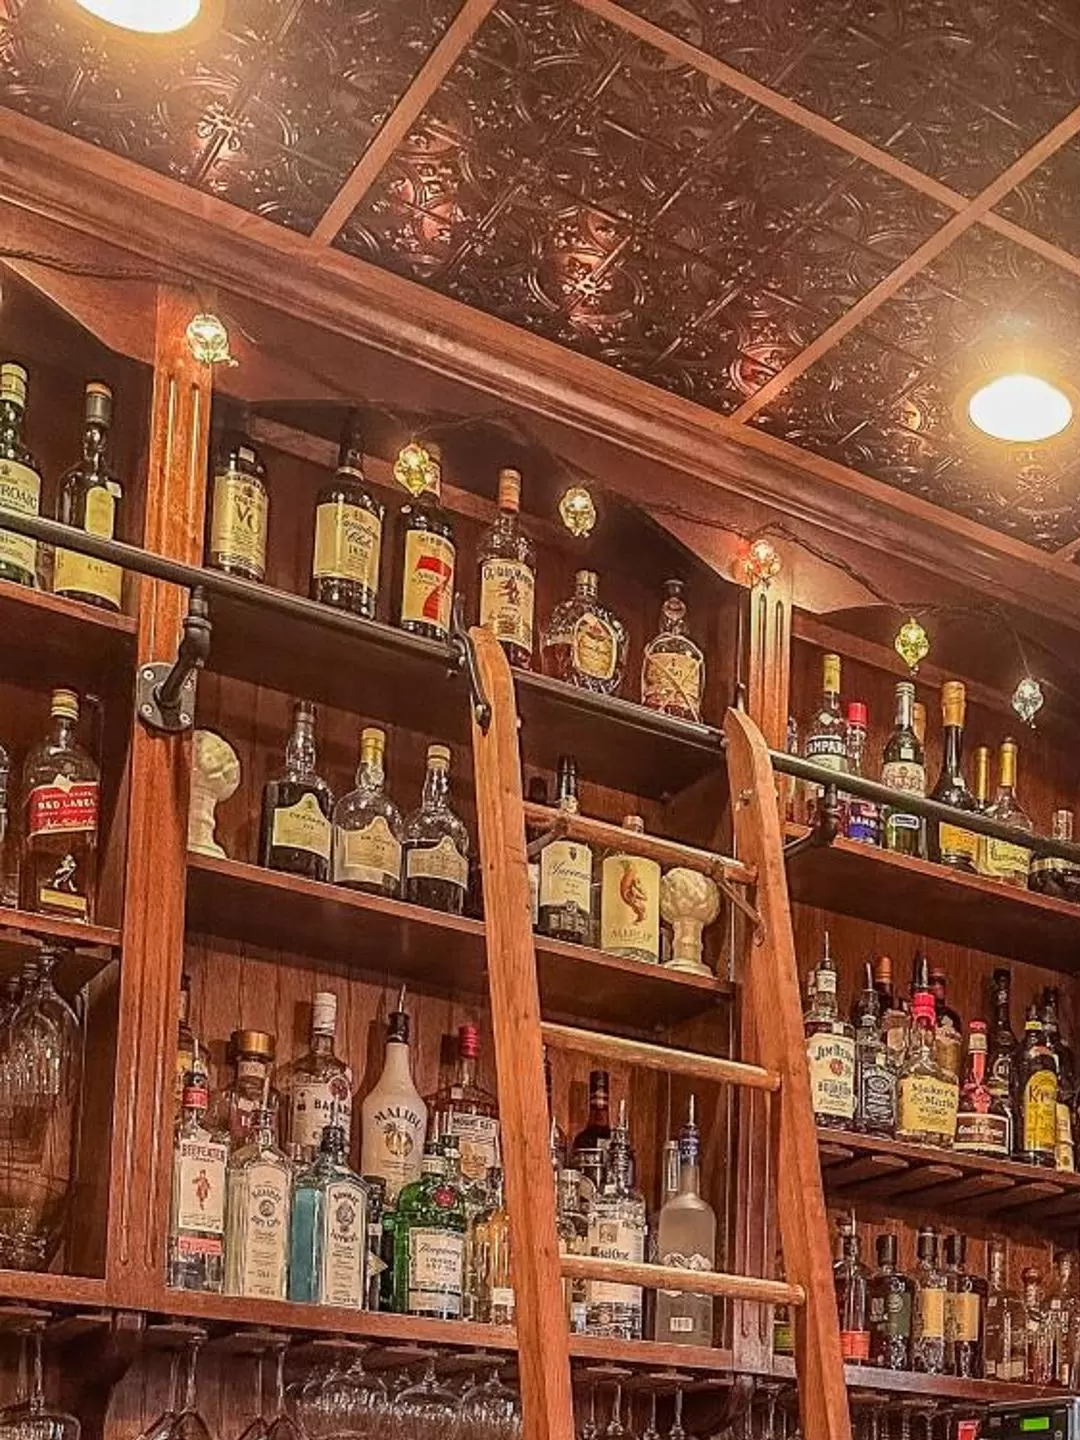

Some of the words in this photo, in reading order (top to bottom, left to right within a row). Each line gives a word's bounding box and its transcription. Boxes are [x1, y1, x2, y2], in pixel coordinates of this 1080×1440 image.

[416, 554, 452, 620] 7
[38, 801, 60, 810] RED
[62, 798, 96, 809] LABEL
[374, 1106, 422, 1130] MALIBU
